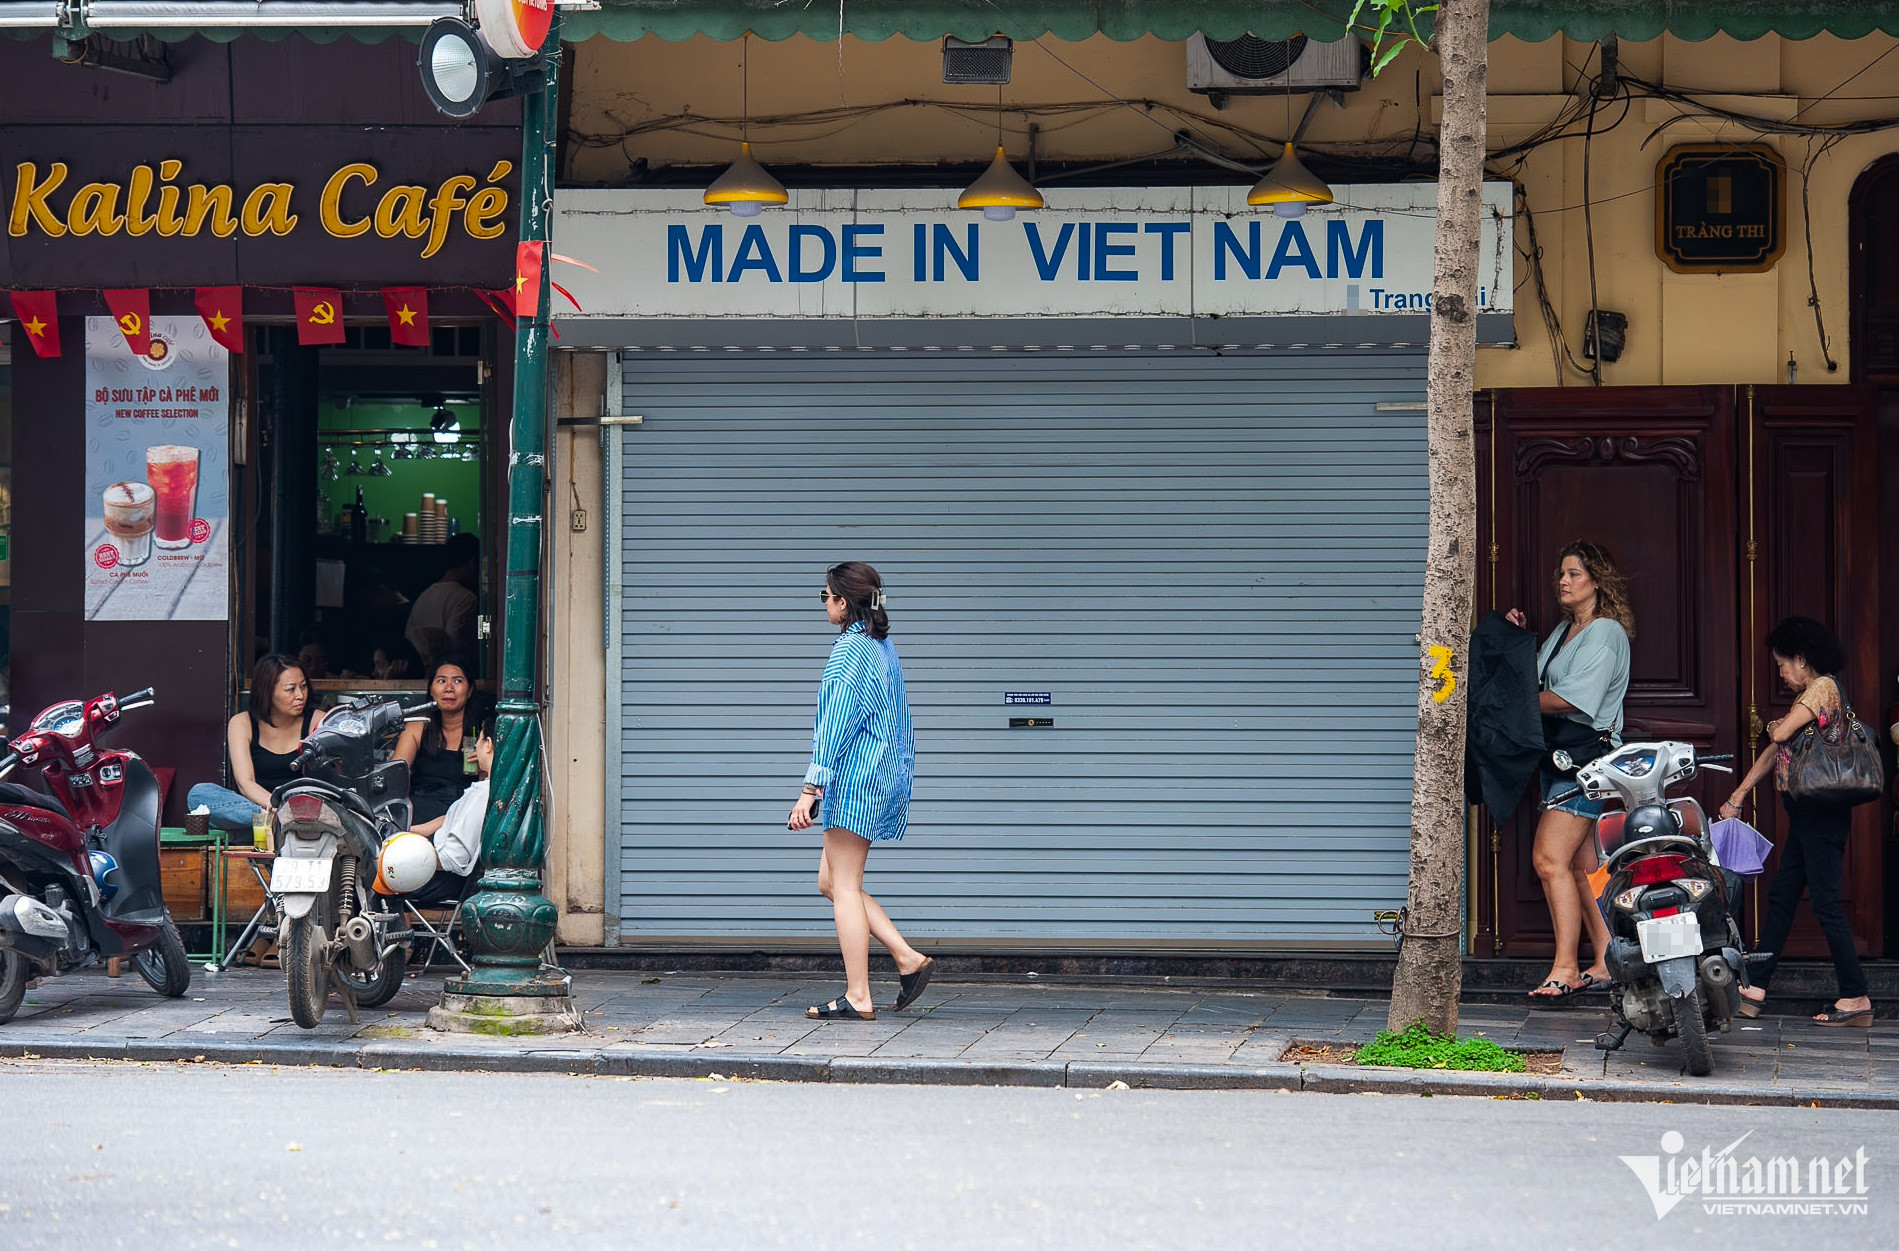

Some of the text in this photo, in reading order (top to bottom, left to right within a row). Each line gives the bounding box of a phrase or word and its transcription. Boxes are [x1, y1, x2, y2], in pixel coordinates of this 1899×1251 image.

[9, 159, 513, 259] Kalina Café
[1736, 224, 1766, 238] THI
[667, 219, 1385, 283] MADE IN VIET NAM
[95, 386, 109, 405] BỘ
[112, 387, 133, 402] SƯU
[136, 386, 157, 405] TẬP
[159, 386, 173, 402] CÀ
[175, 386, 197, 402] PHÊ
[115, 409, 199, 418] NEW COFFEE SELECTION
[1428, 644, 1456, 704] 3
